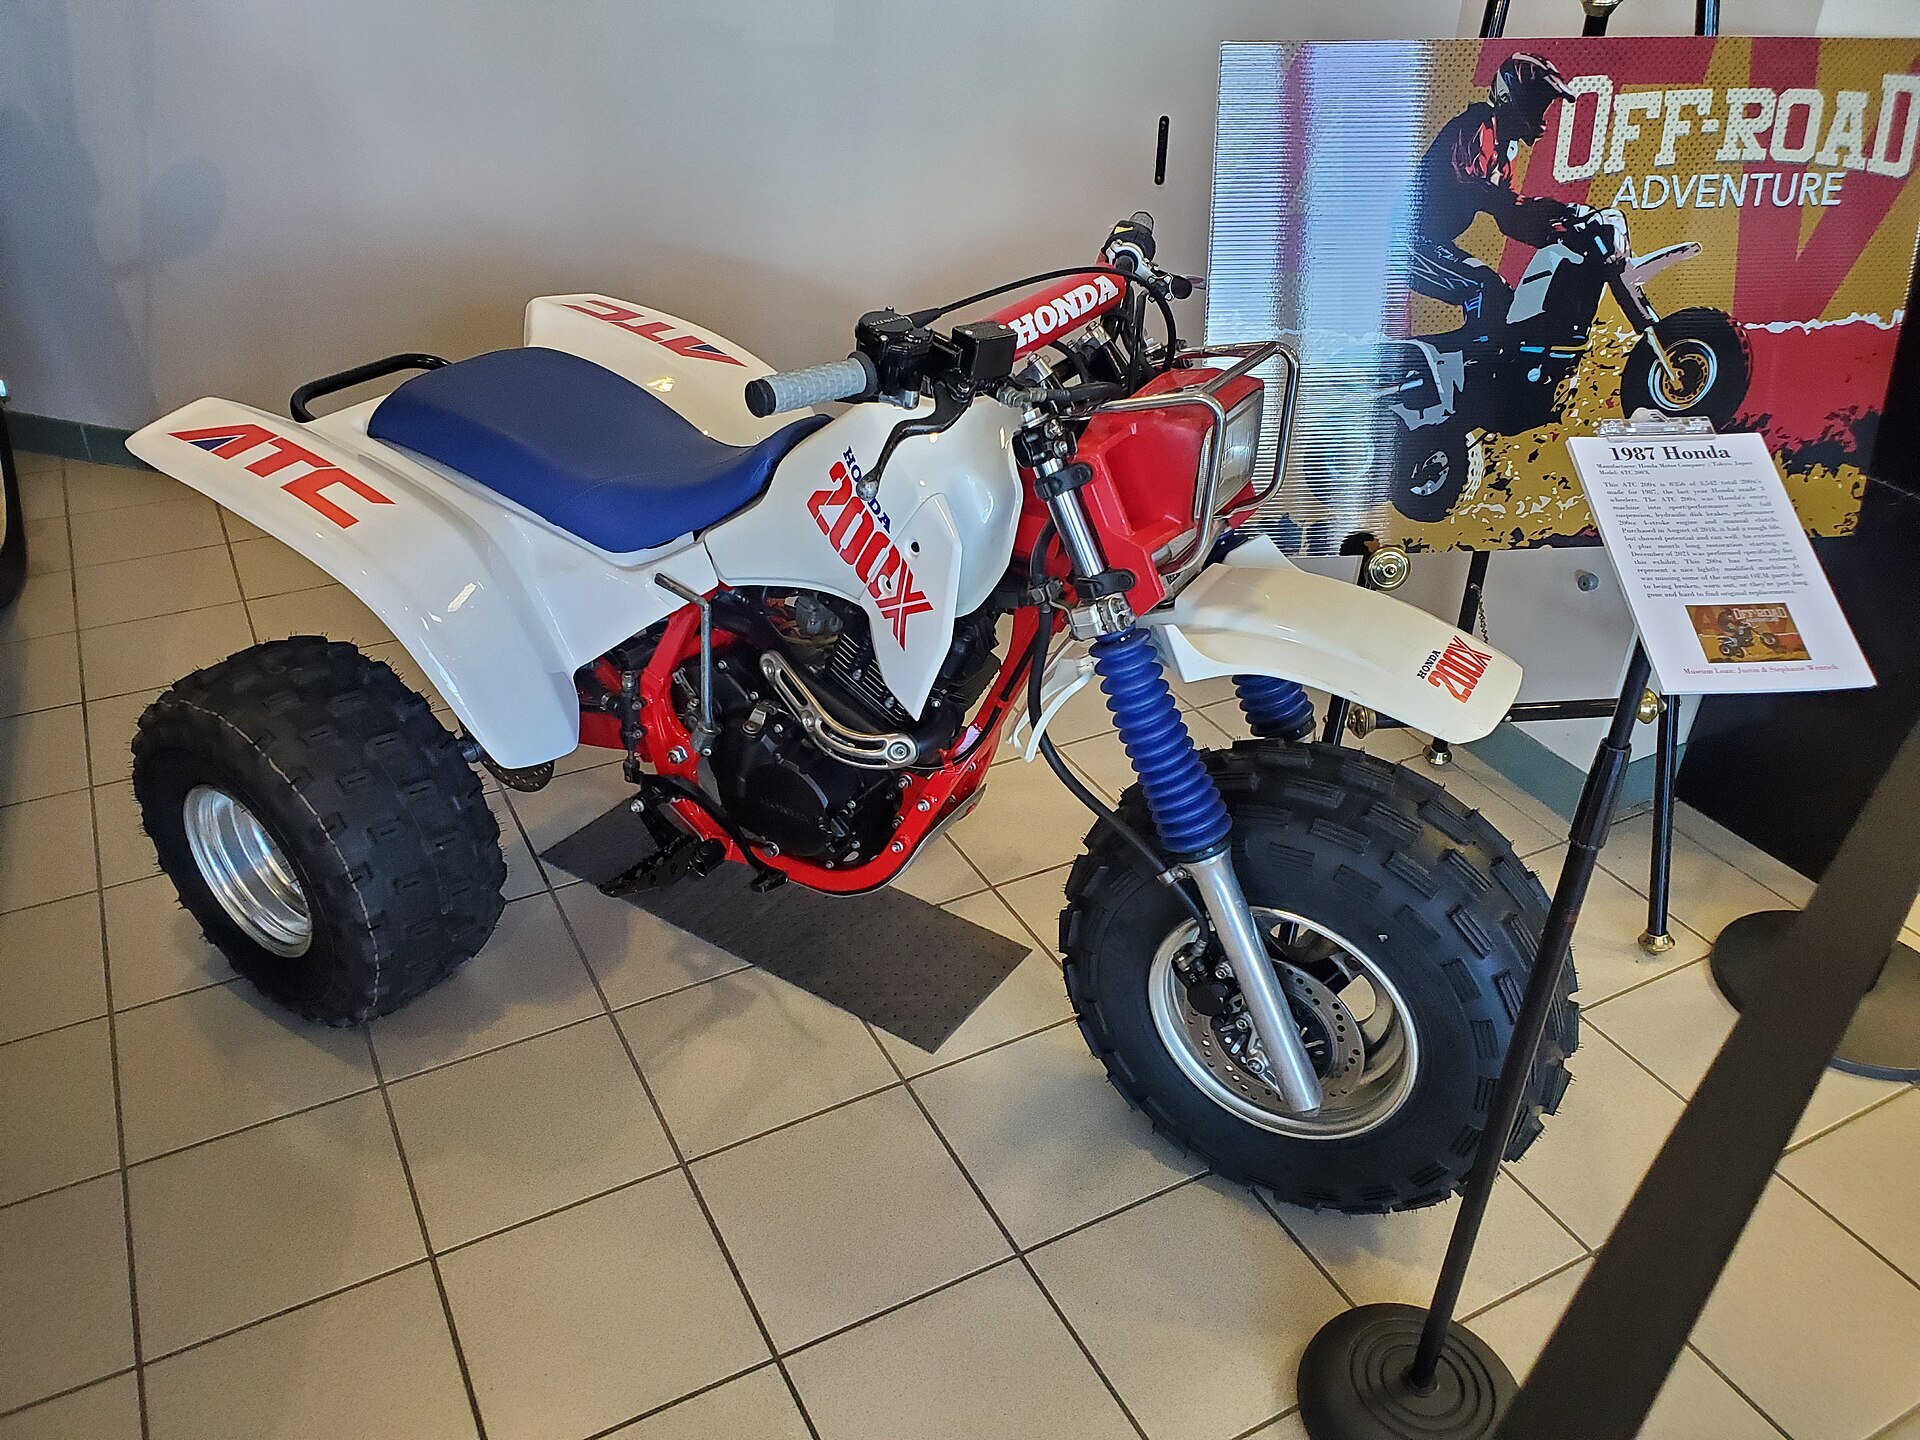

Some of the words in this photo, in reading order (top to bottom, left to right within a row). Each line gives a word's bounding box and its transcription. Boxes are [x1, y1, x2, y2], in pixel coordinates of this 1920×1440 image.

[1553, 73, 1920, 184] OFF-ROAD
[1610, 171, 1847, 210] ADVENTURE
[561, 300, 748, 367] ATC
[1008, 275, 1119, 350] HONDA
[167, 423, 397, 529] ATC
[1609, 446, 1656, 461] 1987
[1661, 444, 1731, 461] Honda
[842, 445, 891, 534] HODA
[1733, 508, 1775, 516] performance
[806, 460, 934, 652] 200X
[1417, 650, 1441, 679] HONDA
[1428, 635, 1493, 704] 200X
